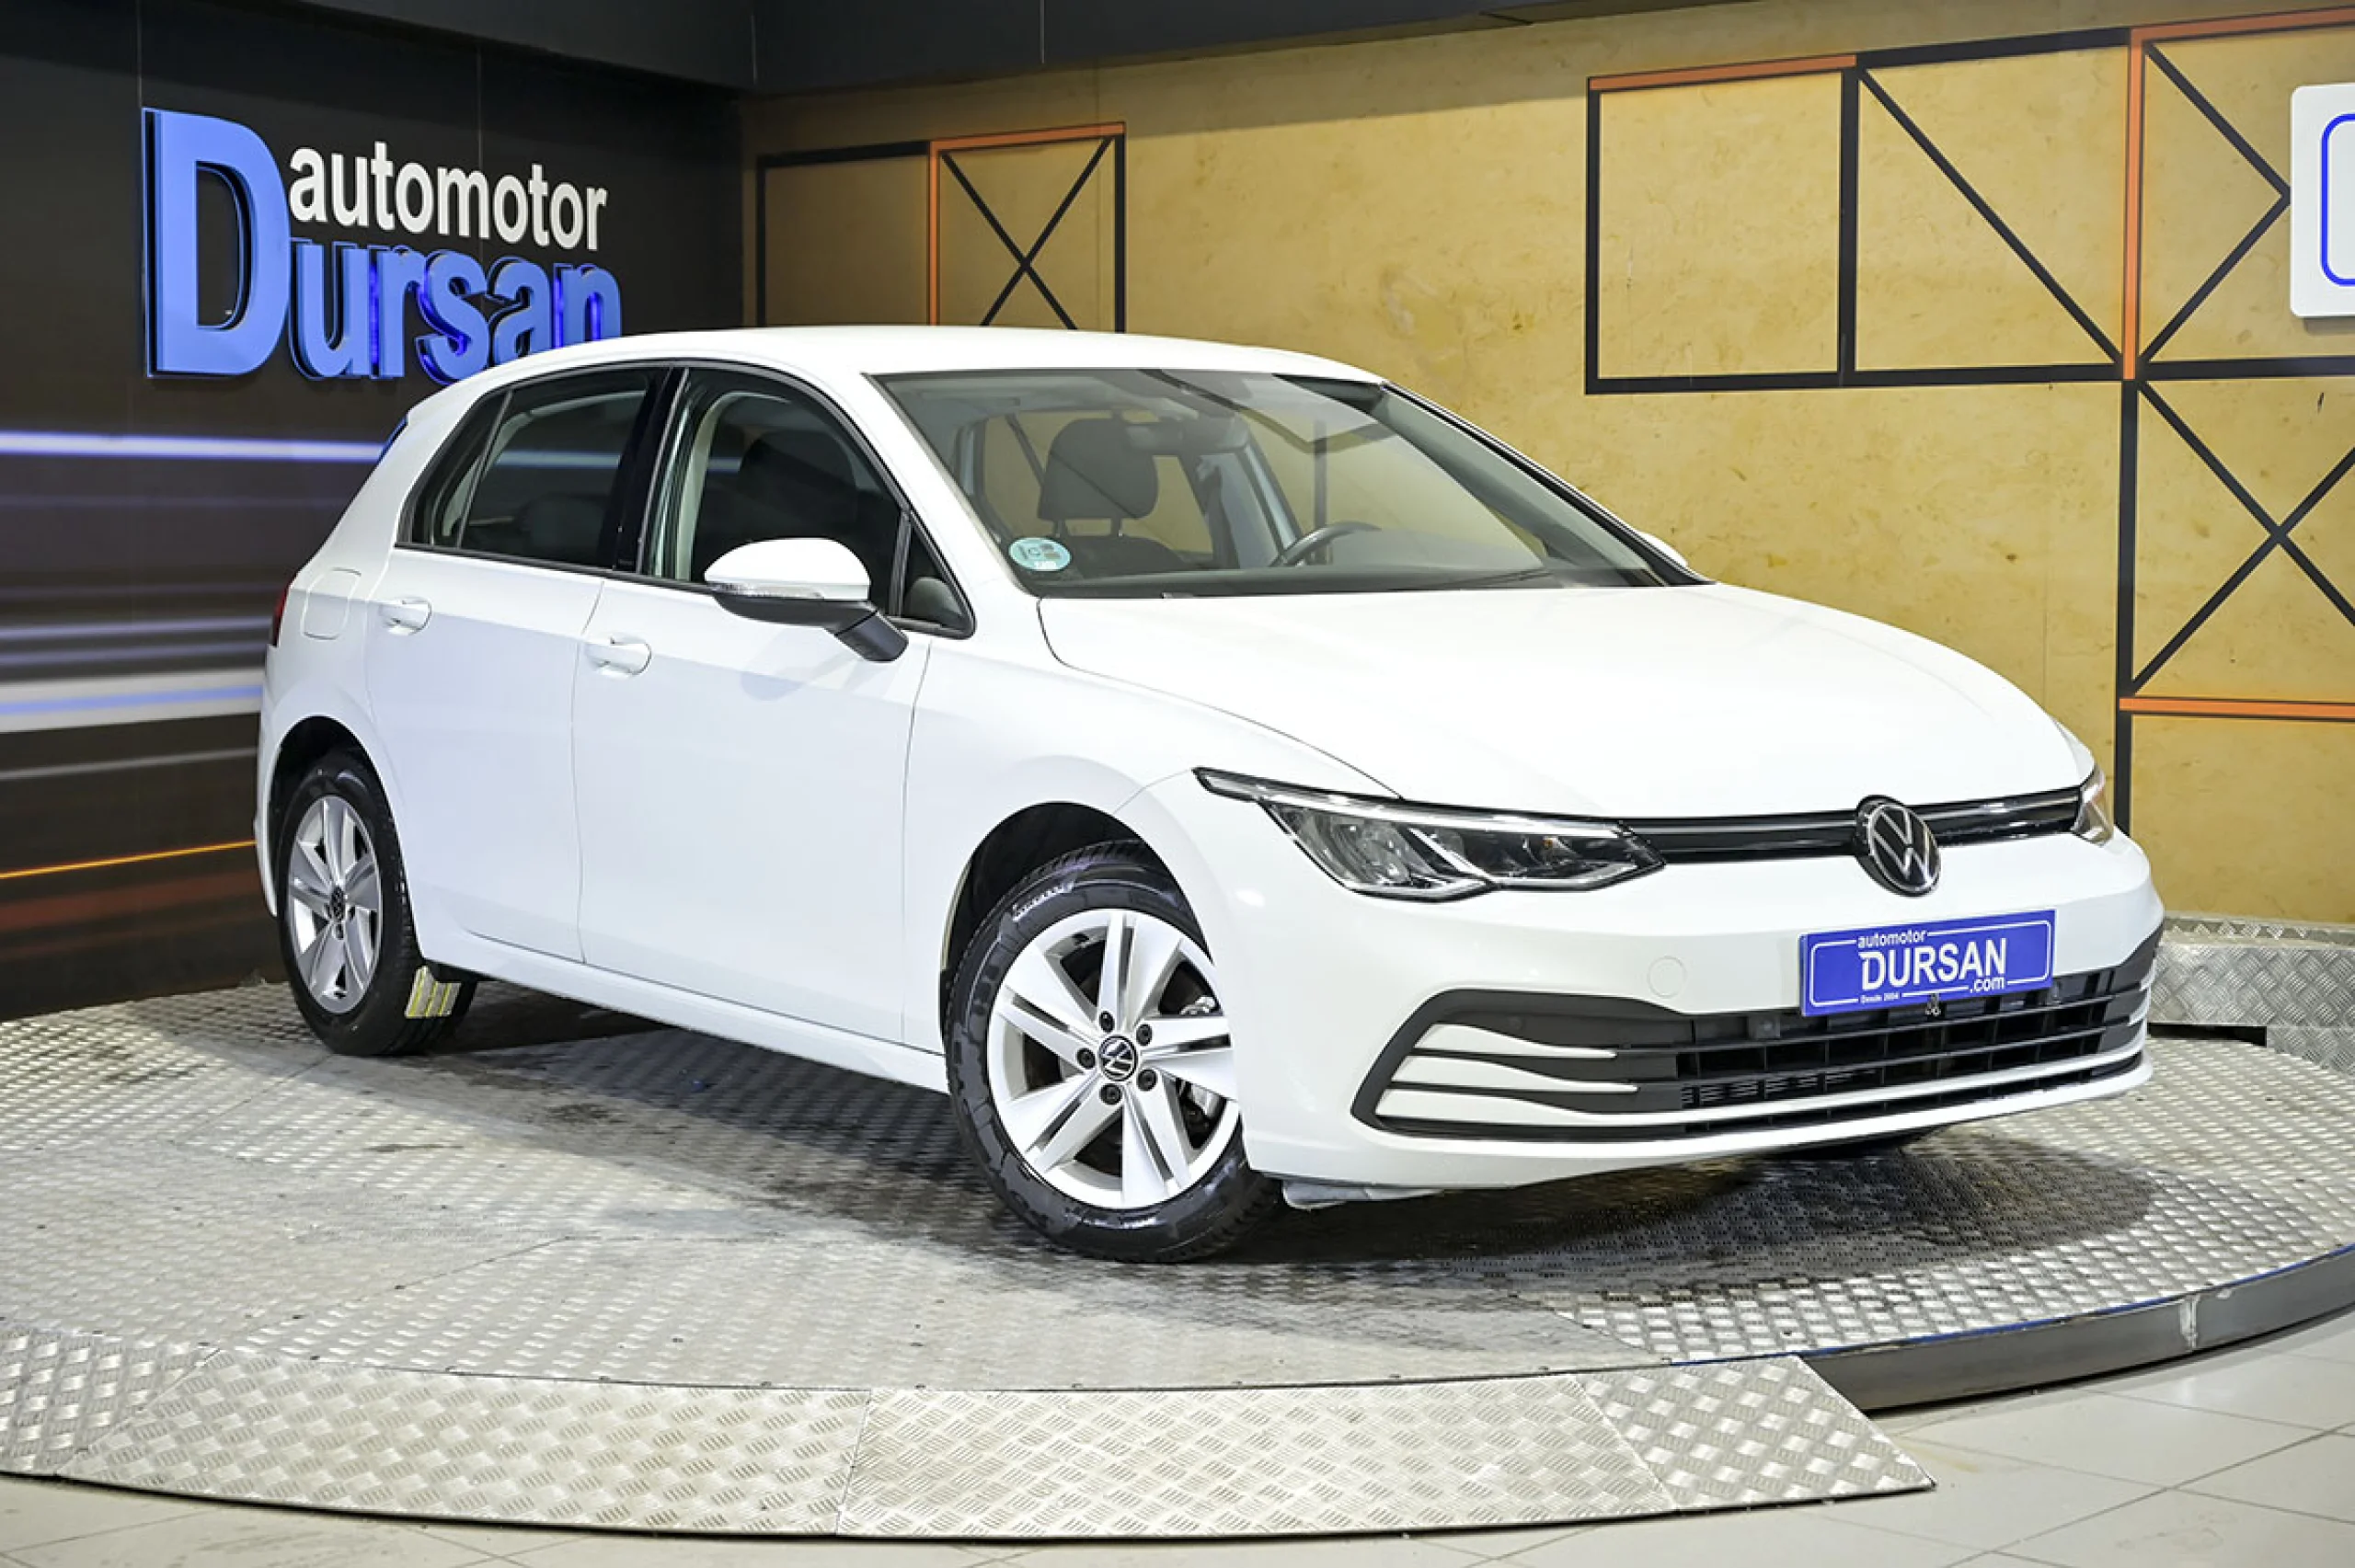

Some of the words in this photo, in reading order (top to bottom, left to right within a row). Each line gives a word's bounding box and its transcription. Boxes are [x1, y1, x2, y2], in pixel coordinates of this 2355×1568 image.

[289, 142, 607, 250] automotor
[142, 107, 623, 386] Dursan
[1857, 929, 1926, 948] automotor
[1857, 937, 2006, 991] DURSAN
[1970, 976, 2005, 993] .com
